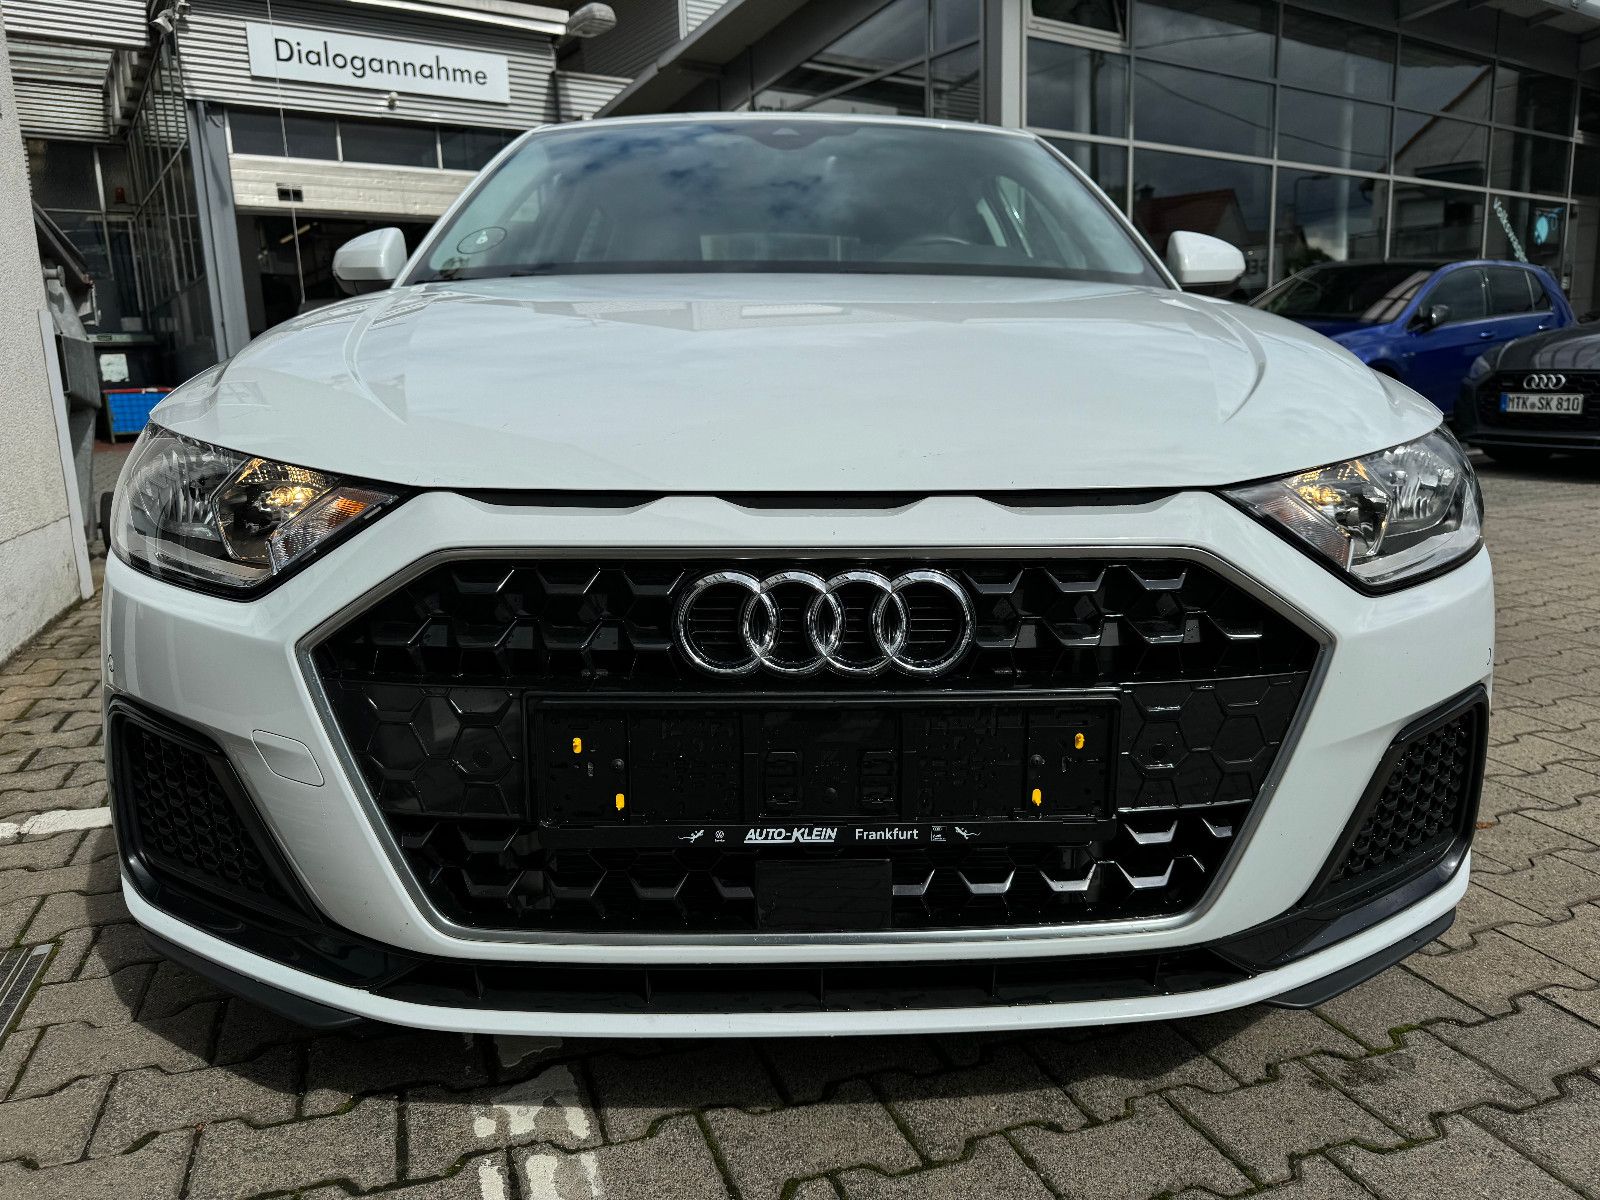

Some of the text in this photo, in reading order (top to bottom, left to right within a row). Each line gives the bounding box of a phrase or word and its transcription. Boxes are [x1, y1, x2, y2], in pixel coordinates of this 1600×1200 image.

[274, 38, 488, 85] Dialogannahme
[1537, 396, 1554, 411] SK
[1556, 397, 1580, 412] 810
[744, 827, 838, 842] AUTO-KLEIN
[855, 828, 919, 840] Frankfurt
